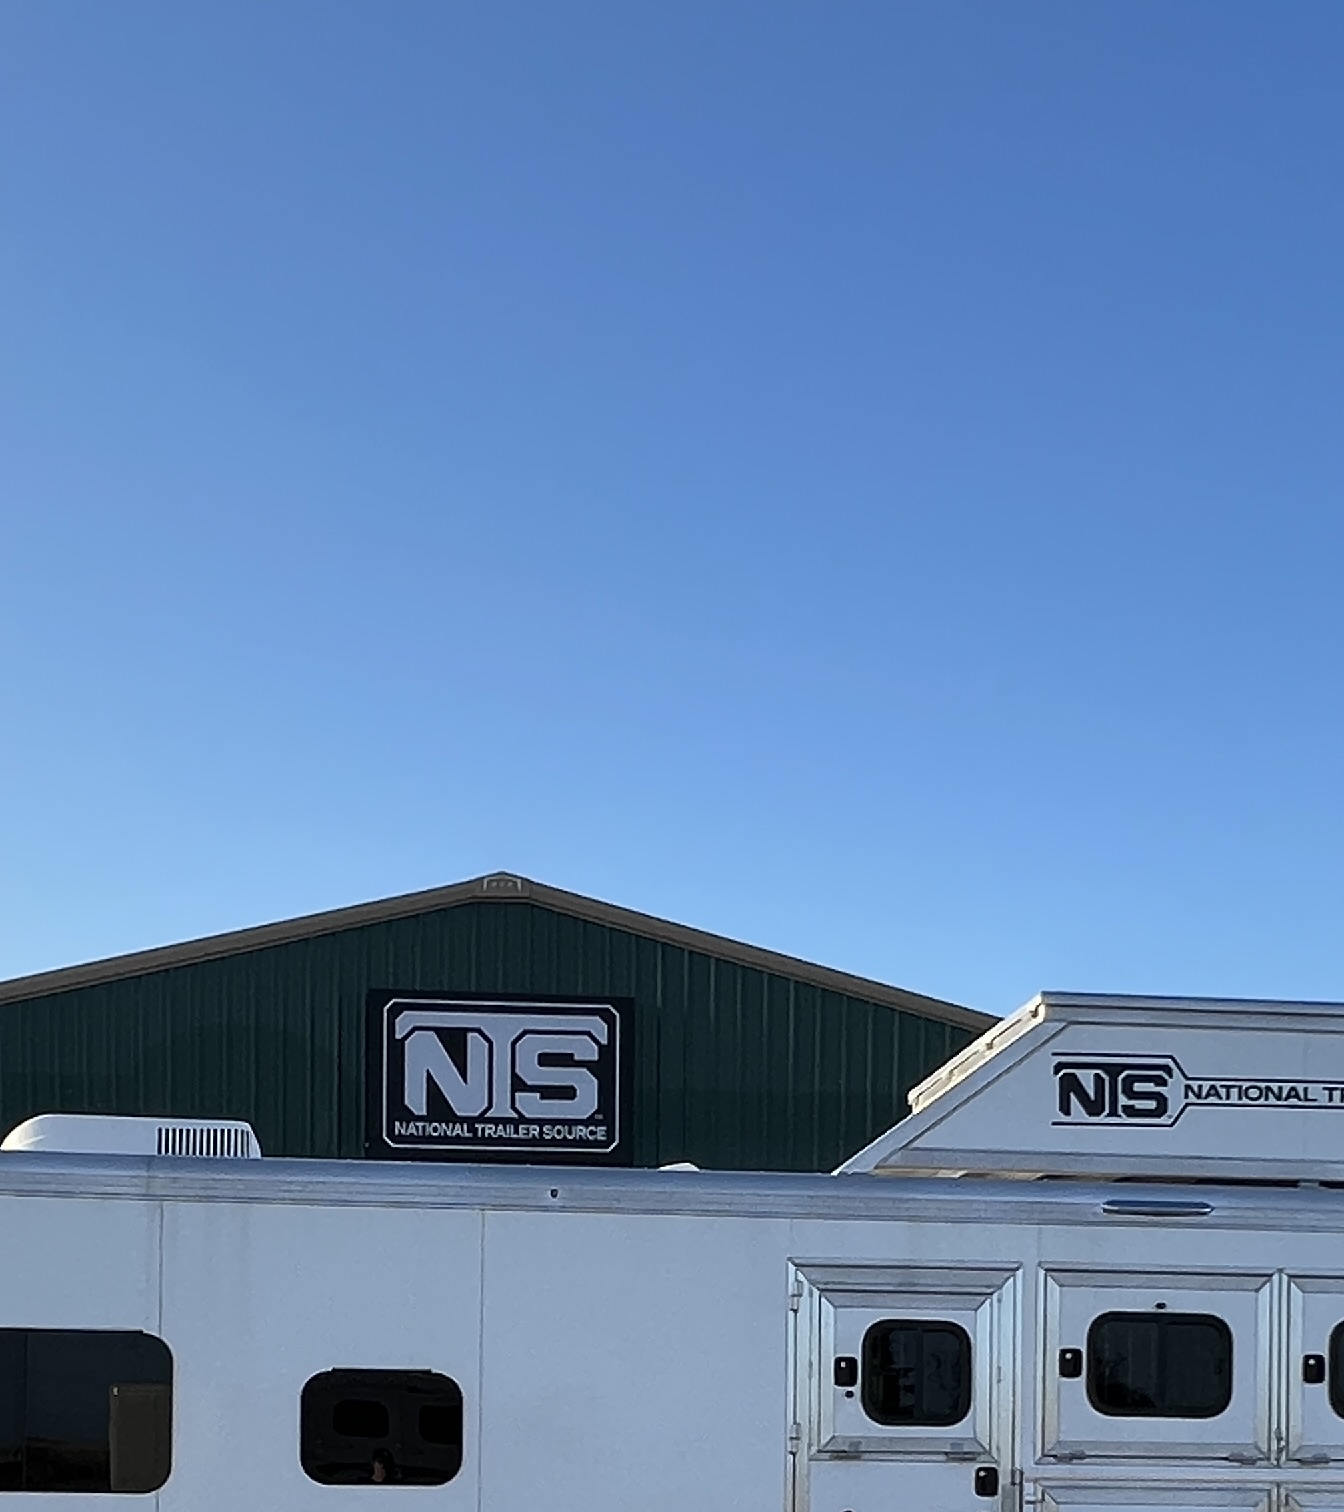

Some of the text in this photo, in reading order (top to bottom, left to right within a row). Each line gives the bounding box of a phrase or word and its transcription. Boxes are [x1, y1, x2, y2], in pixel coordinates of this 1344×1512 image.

[395, 1010, 607, 1119] NTS
[1053, 1061, 1173, 1118] NTS
[1183, 1083, 1318, 1103] NATIONAL
[394, 1120, 607, 1141] NATIONAL TRAILER SOURCE
